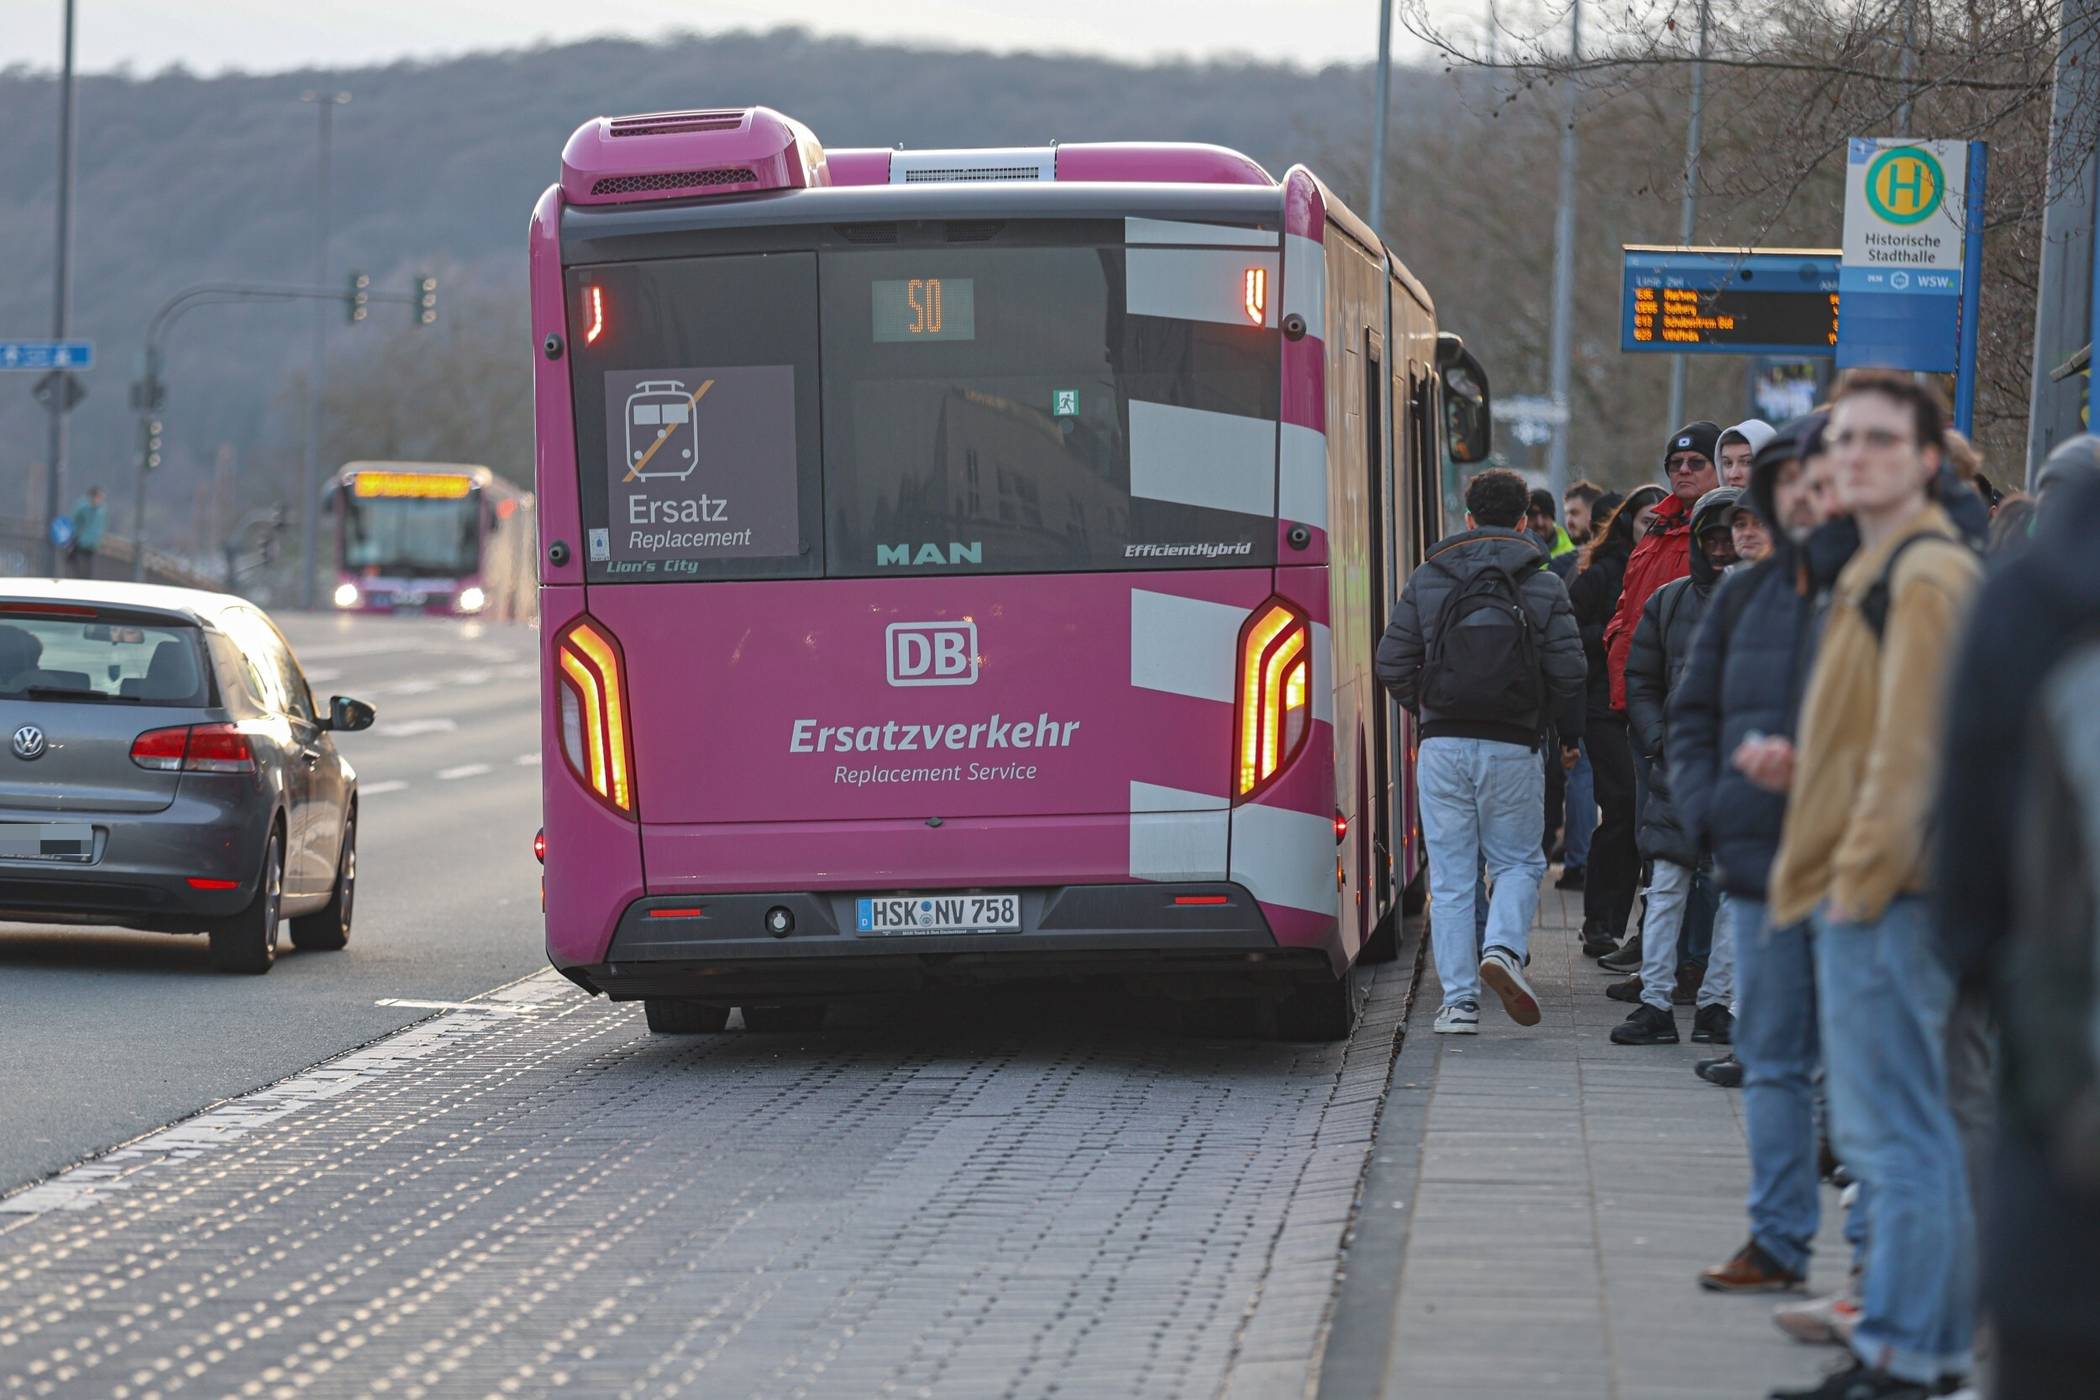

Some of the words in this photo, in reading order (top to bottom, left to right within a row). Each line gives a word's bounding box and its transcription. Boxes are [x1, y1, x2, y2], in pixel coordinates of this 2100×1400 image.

[1888, 164, 1922, 208] H
[1865, 232, 1941, 248] Historische
[1868, 248, 1936, 264] Stadthalle
[1917, 275, 1949, 288] WSW
[629, 494, 728, 524] Ersatz
[629, 528, 752, 552] Replacement
[1124, 542, 1251, 558] EfficientHybrid
[877, 541, 983, 566] MAN
[606, 560, 657, 573] Lion's
[664, 559, 699, 574] City
[897, 631, 967, 676] DB
[789, 712, 1081, 753] Ersatzverkehr
[833, 763, 961, 787] Replacement
[967, 762, 1038, 781] Service
[873, 900, 918, 926] HSK
[935, 900, 965, 925] NV
[971, 898, 1015, 924] 758
